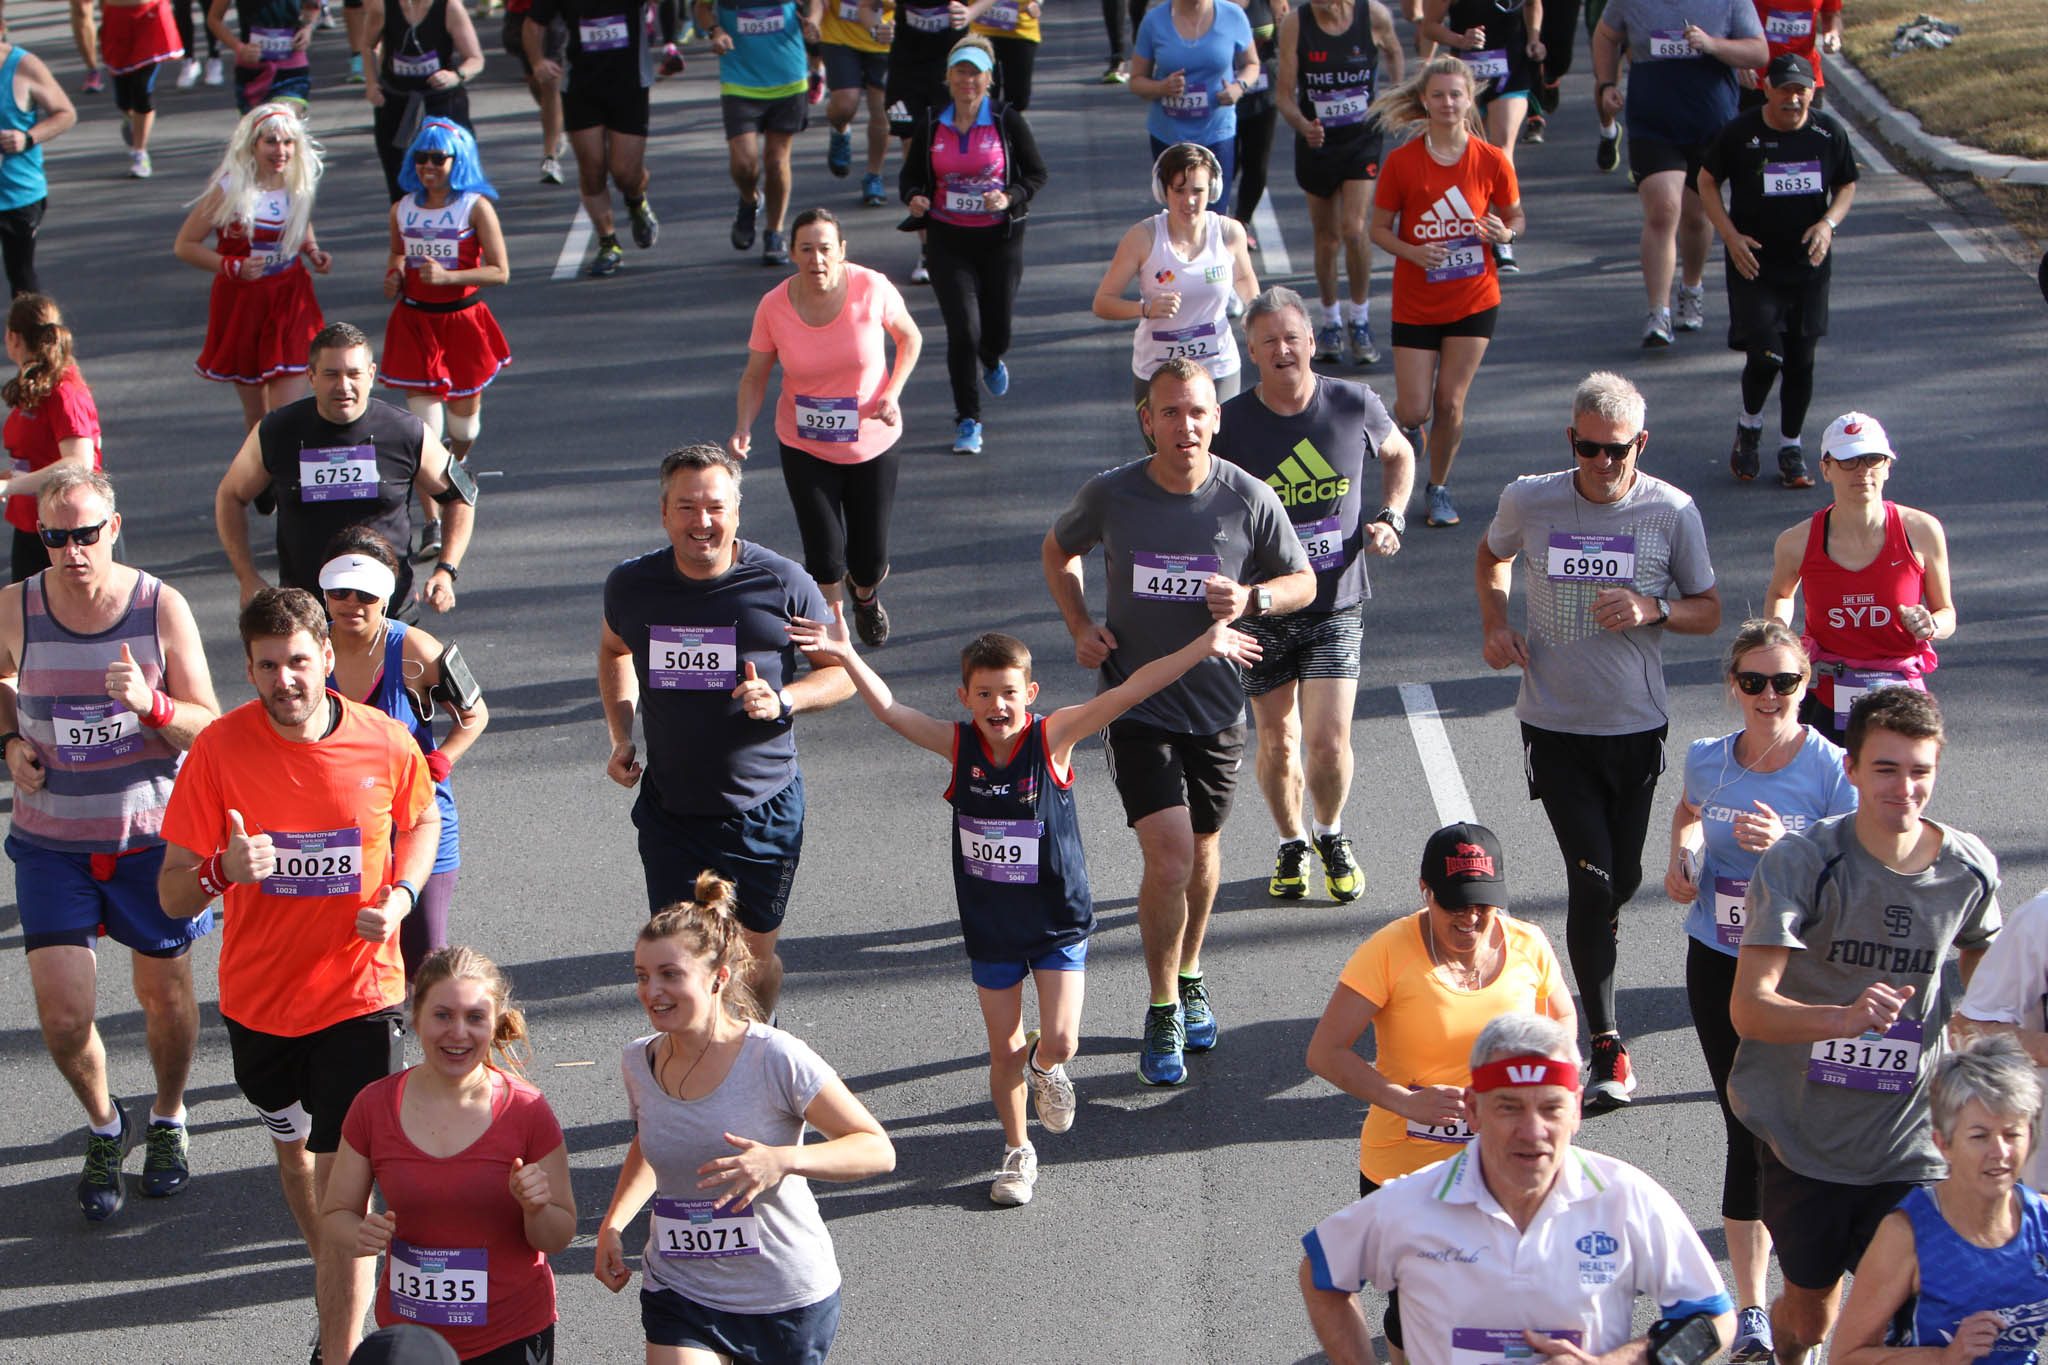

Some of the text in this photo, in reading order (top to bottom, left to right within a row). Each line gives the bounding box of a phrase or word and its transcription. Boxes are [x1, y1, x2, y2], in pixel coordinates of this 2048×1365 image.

[1306, 69, 1370, 85] THE UofA
[1325, 101, 1359, 116] 4785
[1775, 178, 1812, 192] 8635
[956, 198, 983, 210] 997
[1413, 218, 1477, 240] adida
[409, 244, 452, 257] 10356
[1446, 252, 1474, 267] 153
[1165, 342, 1207, 359] 7352
[806, 414, 847, 429] 9297
[315, 467, 363, 485] 6752
[1276, 478, 1350, 507] didas
[1307, 539, 1331, 557] 58
[1563, 557, 1618, 577] 6990
[1147, 576, 1203, 596] 4427
[1842, 596, 1855, 605] SHE
[1828, 605, 1892, 628] SYD
[664, 651, 721, 671] 5048
[69, 721, 123, 744] 9757
[971, 841, 1022, 864] 5049
[272, 855, 352, 877] 10028
[327, 886, 350, 894] 10028
[1825, 939, 1938, 975] FOOTBAL
[1823, 1040, 1908, 1071] 13178
[667, 1226, 749, 1252] 13071
[1578, 1260, 1616, 1272] HEALTH
[397, 1272, 476, 1302] 13135
[448, 1315, 473, 1323] 13135
